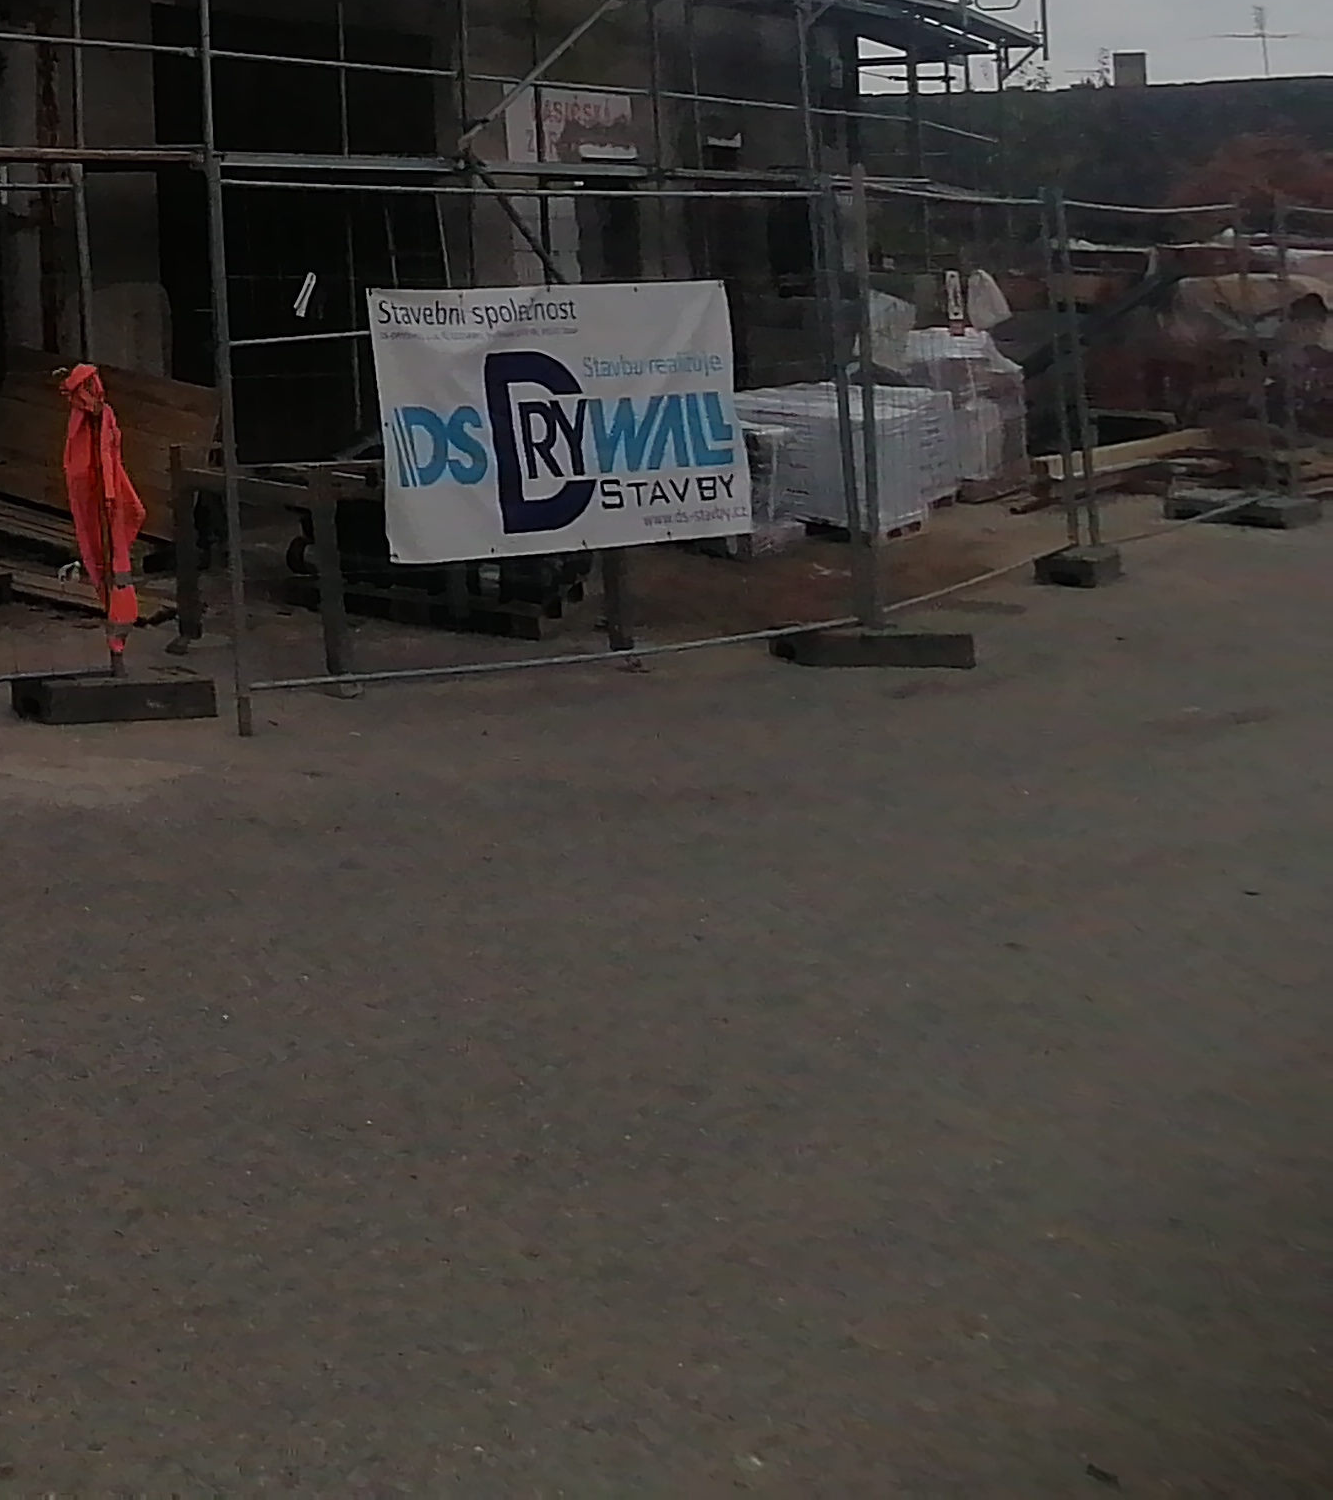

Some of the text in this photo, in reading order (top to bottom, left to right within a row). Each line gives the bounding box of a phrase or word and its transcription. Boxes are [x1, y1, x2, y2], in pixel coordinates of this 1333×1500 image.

[378, 297, 577, 329] Stavební společnost
[600, 474, 734, 509] STAVBY
